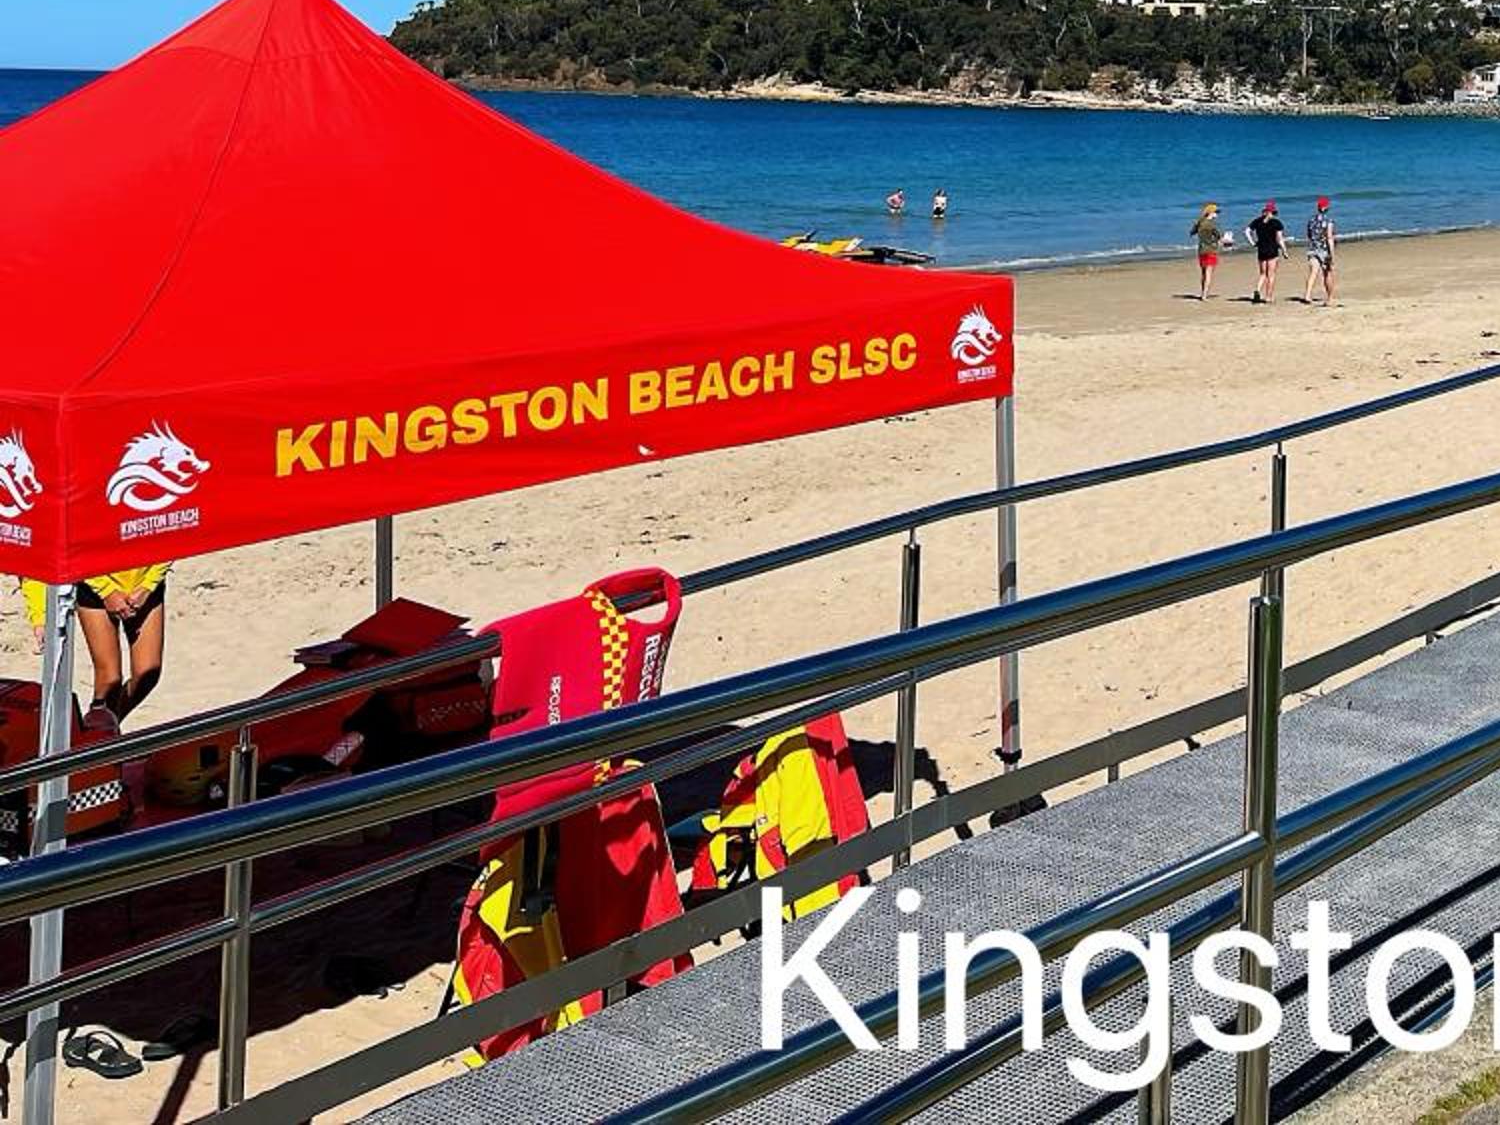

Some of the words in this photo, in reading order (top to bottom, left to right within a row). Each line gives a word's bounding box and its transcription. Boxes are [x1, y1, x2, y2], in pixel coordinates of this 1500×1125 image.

[276, 378, 609, 477] KINGSTON
[629, 350, 795, 414] BEACH
[809, 333, 917, 384] SLSC
[637, 634, 662, 704] RESCU
